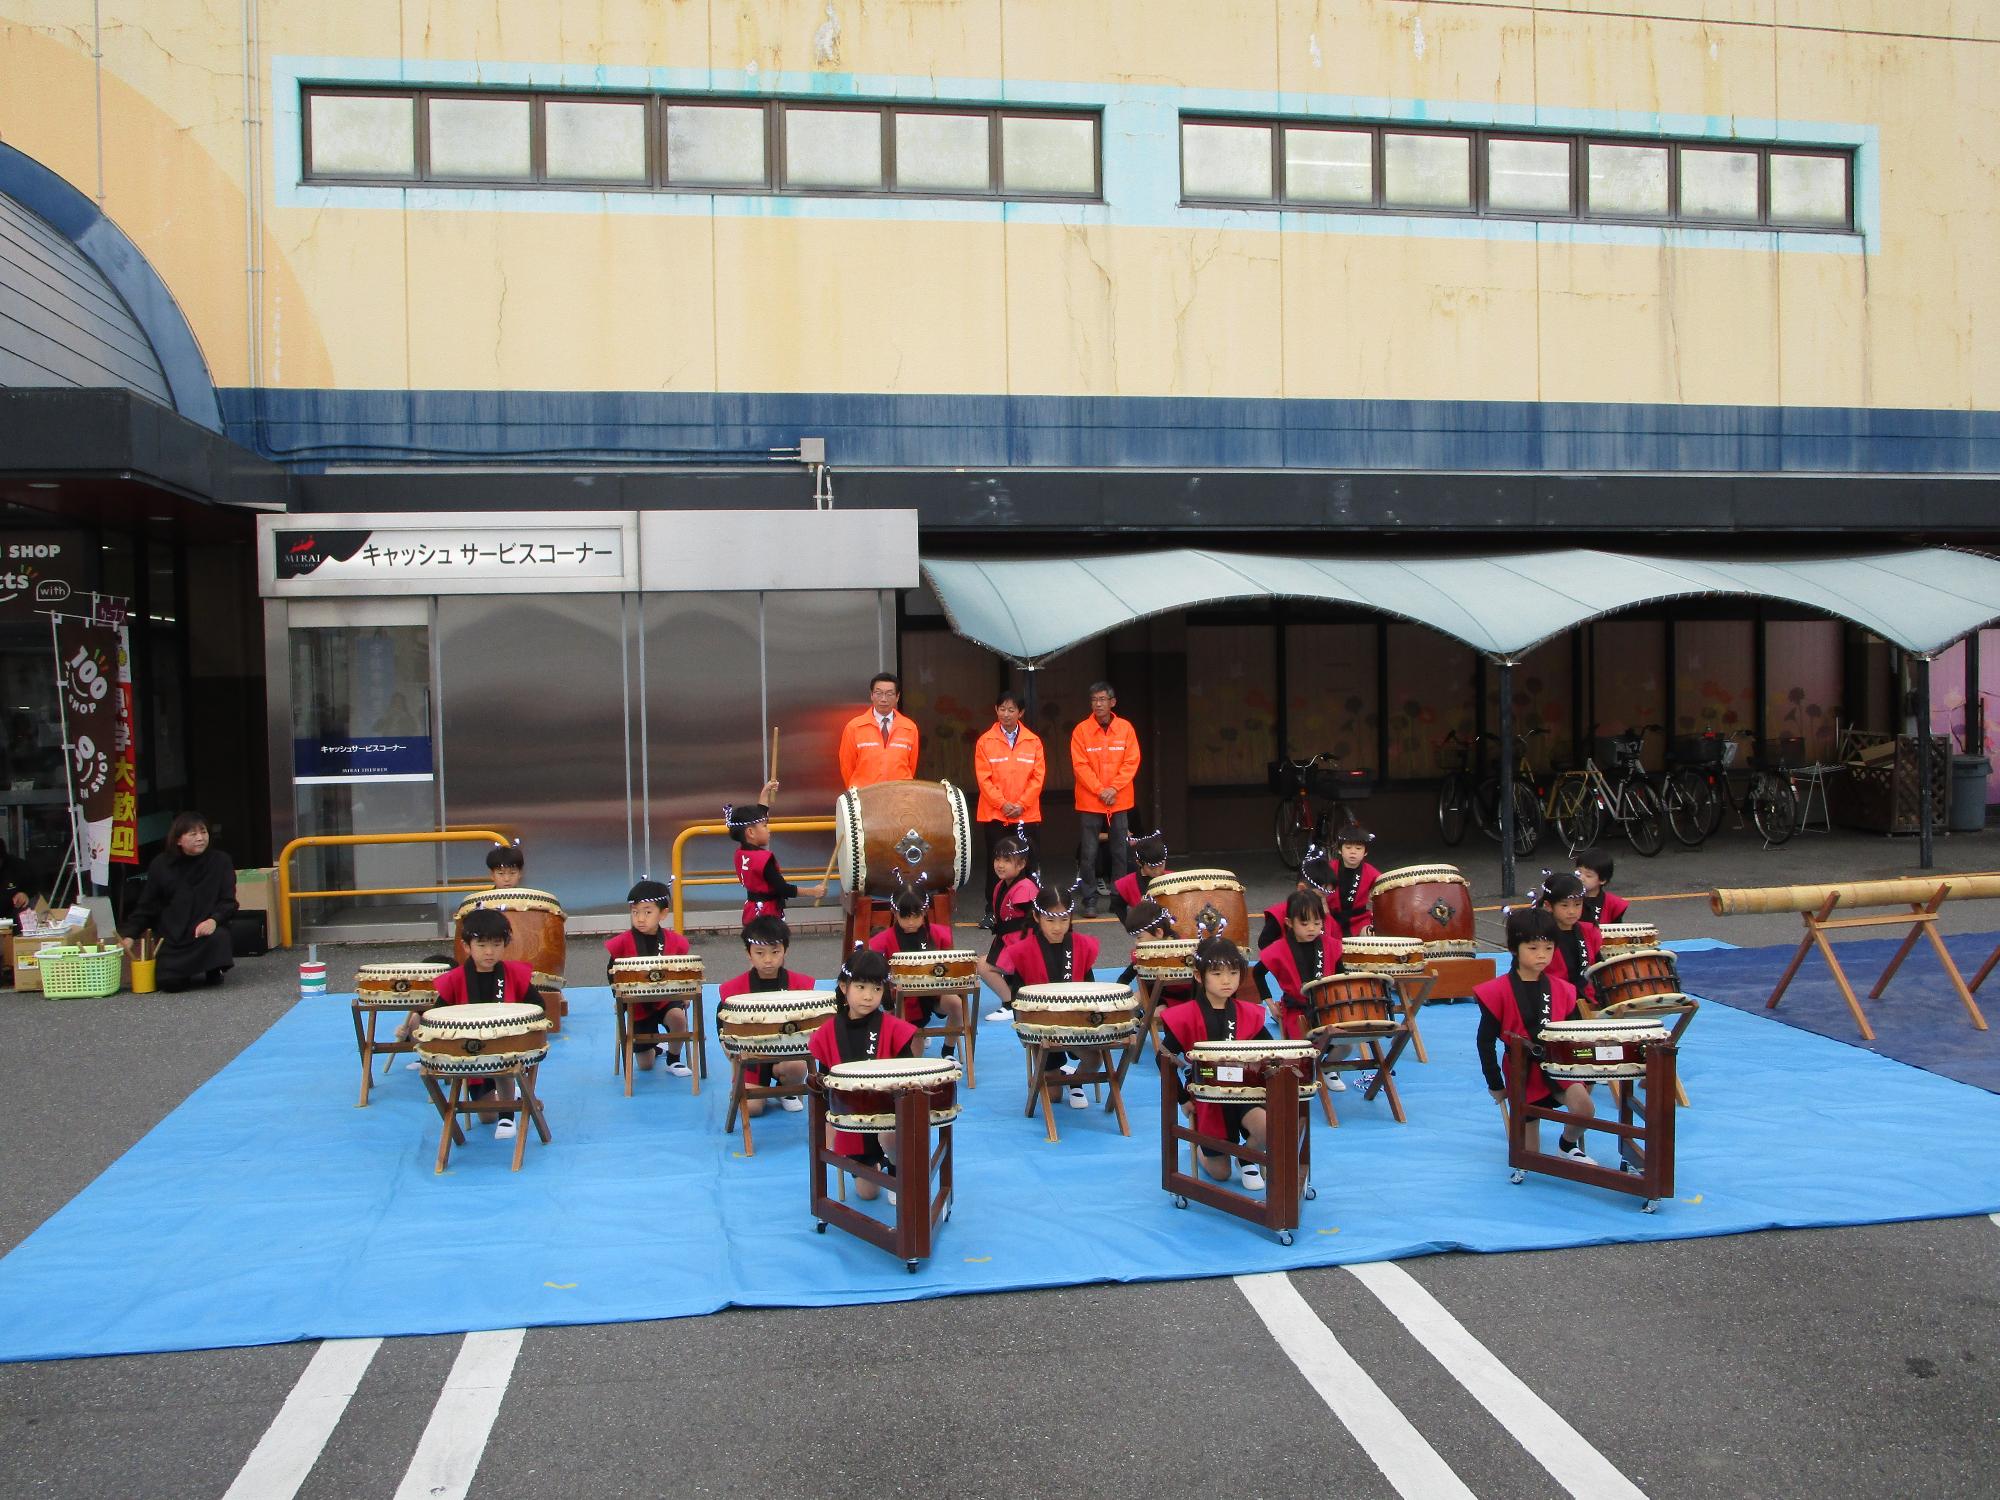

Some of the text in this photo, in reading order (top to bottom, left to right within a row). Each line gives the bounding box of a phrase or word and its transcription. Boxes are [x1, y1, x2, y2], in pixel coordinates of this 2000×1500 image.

[9, 544, 61, 558] SHOP
[284, 554, 321, 563] MIRAI
[362, 541, 613, 567] キャッシュ サービスコーナー
[40, 586, 66, 596] with
[70, 645, 108, 700] 100
[320, 743, 406, 753] キャッシュサービスコーナー
[90, 751, 108, 793] SHOP
[496, 978, 504, 1003] とよ
[866, 1031, 878, 1060] とよ
